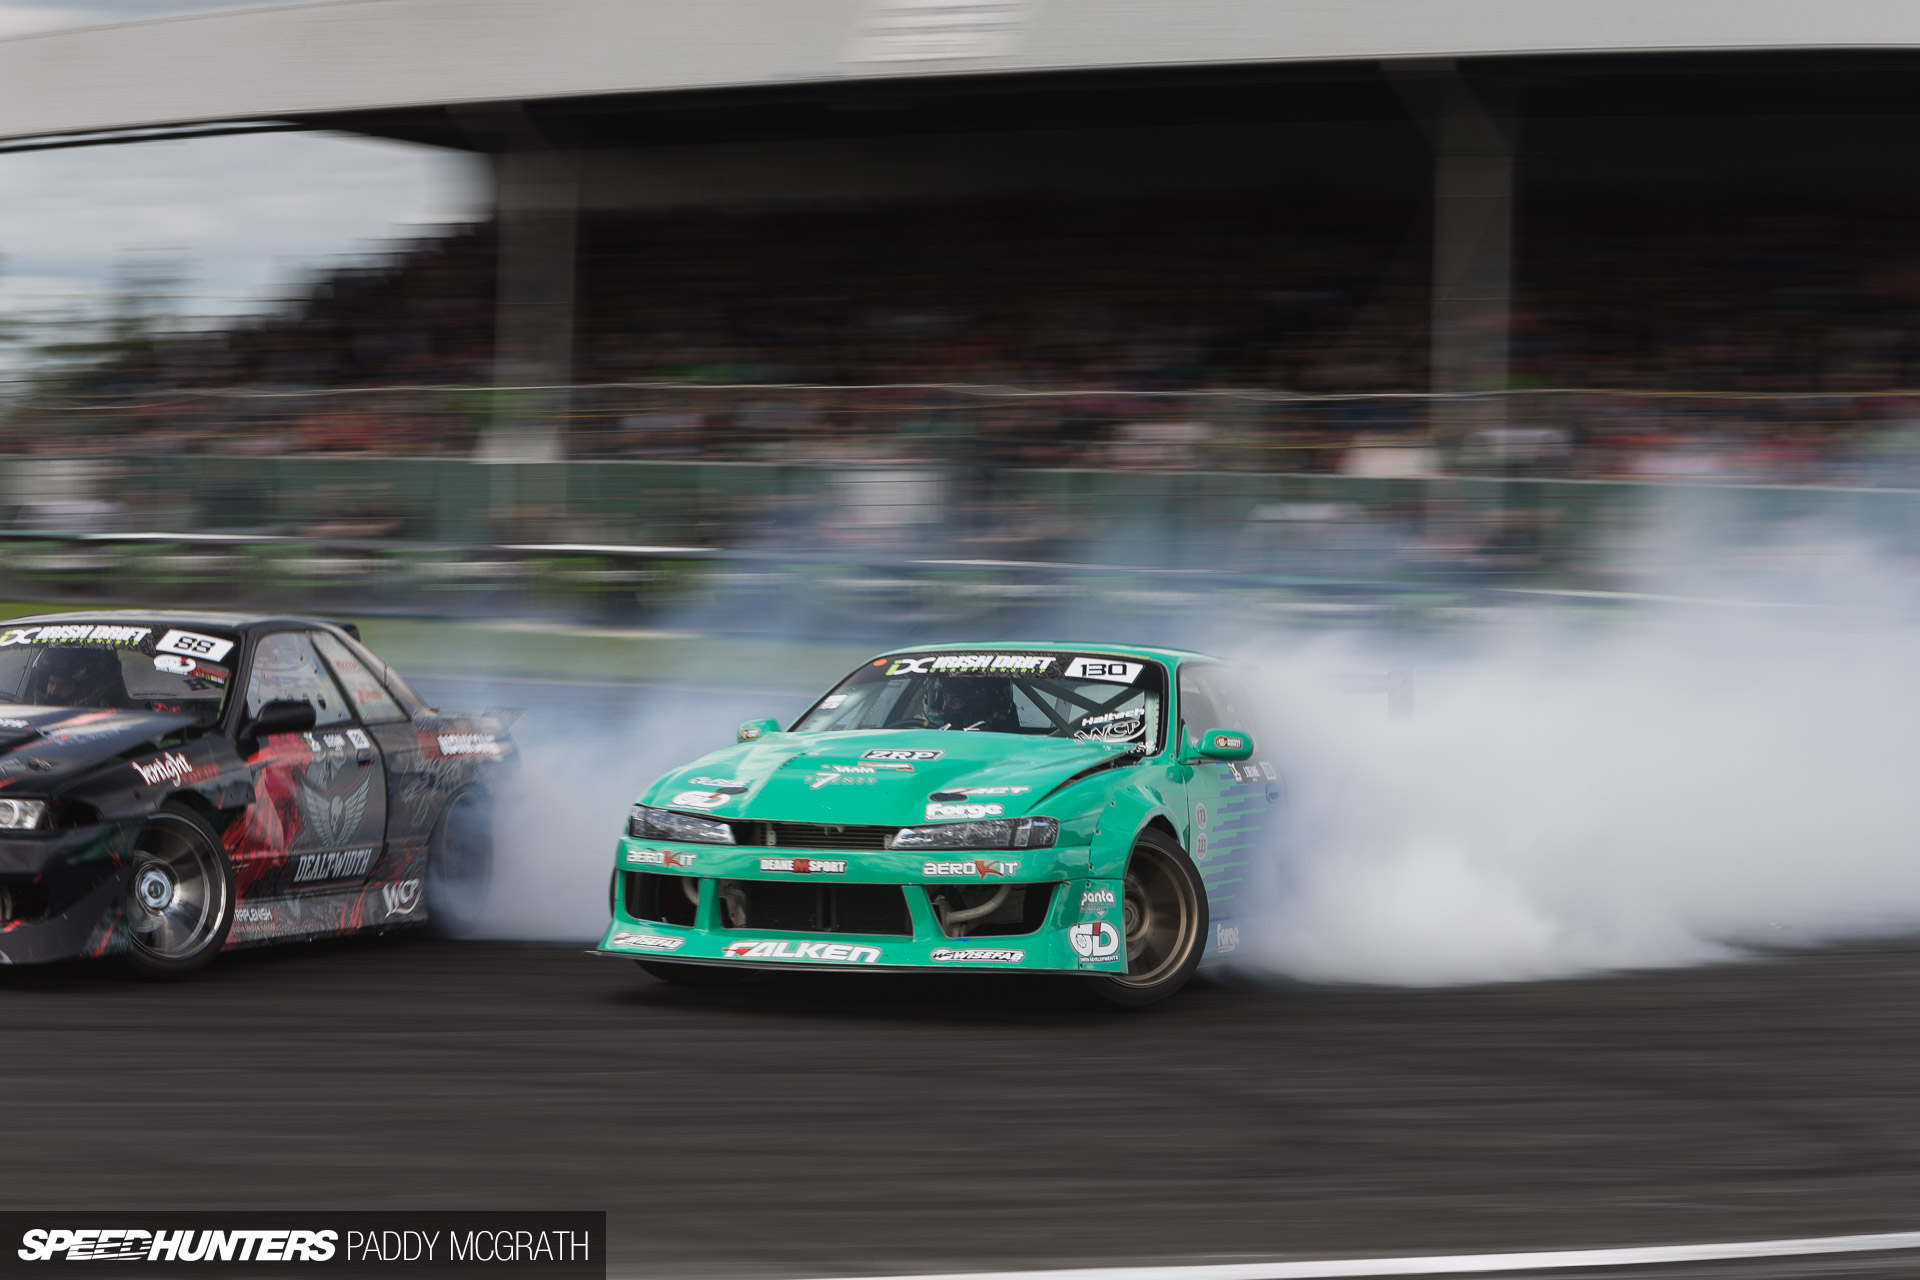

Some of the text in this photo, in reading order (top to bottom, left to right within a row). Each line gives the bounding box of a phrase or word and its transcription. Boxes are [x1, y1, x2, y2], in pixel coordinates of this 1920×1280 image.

[36, 625, 95, 640] IRISH
[89, 625, 152, 642] DRIFT
[173, 636, 216, 654] 88
[931, 655, 995, 669] IRISH
[990, 655, 1056, 669] DRIFT
[1081, 663, 1127, 677] 130
[1081, 708, 1145, 726] Haltech
[865, 749, 937, 761] ZRP
[1080, 889, 1115, 906] panta
[722, 940, 881, 963] FALKEN
